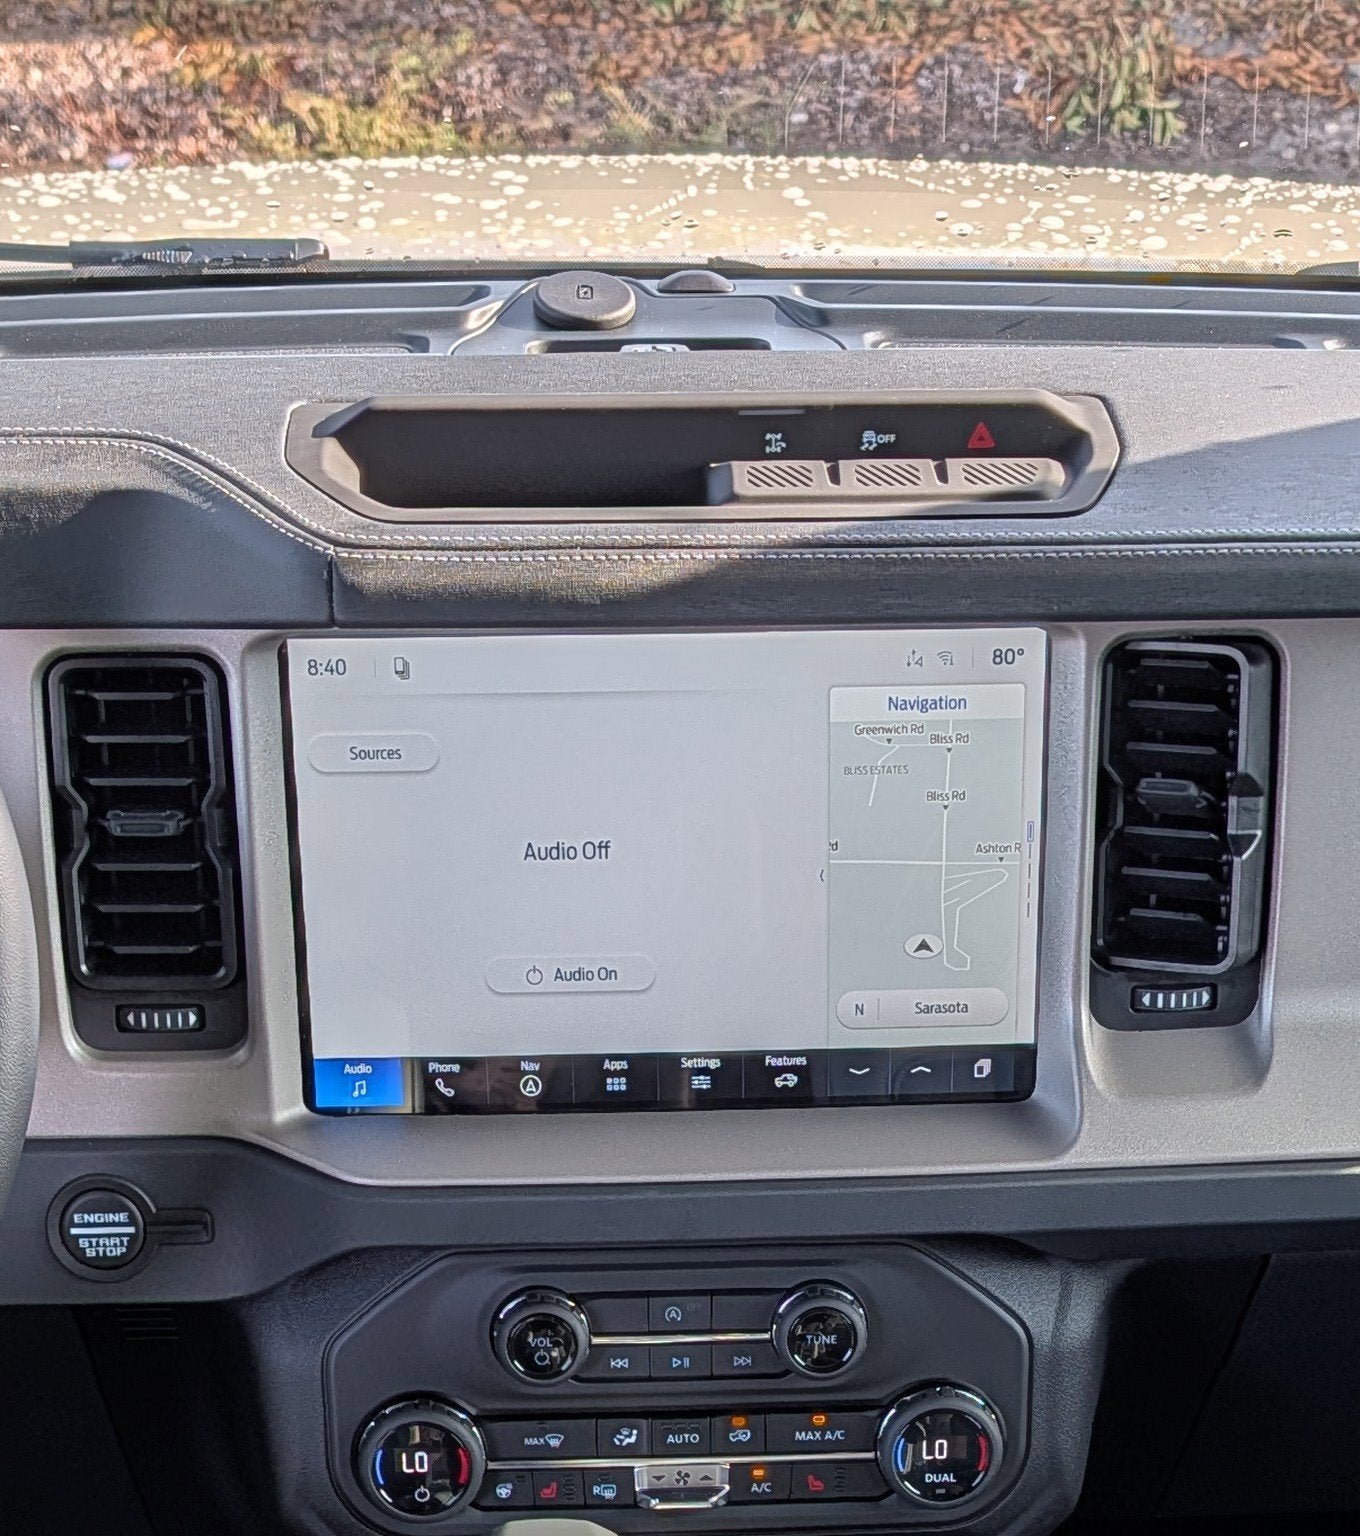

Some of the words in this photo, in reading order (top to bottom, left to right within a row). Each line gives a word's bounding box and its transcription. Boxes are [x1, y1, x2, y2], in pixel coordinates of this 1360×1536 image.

[877, 433, 896, 443] OFF
[307, 658, 347, 676] 8:40
[888, 695, 967, 714] Navigation
[854, 724, 908, 736] Greenwich
[911, 723, 925, 735] Rd
[930, 733, 954, 745] Bliss
[956, 732, 969, 744] Rd
[349, 746, 402, 761] Sources
[844, 765, 868, 776] BLISS
[870, 764, 909, 776] ESTATES
[927, 790, 950, 802] Bliss
[952, 790, 966, 802] Rd
[524, 841, 578, 861] Audio
[582, 840, 611, 860] Off
[975, 842, 1012, 854] Ashton
[554, 967, 594, 982] Audio
[597, 966, 618, 981] On
[855, 1004, 864, 1016] N
[915, 1002, 969, 1015] Sarasota
[521, 1061, 540, 1072] Nav
[603, 1059, 628, 1071] Apps
[681, 1057, 721, 1070] Settings
[765, 1055, 807, 1067] Features
[344, 1063, 372, 1075] Audio
[428, 1062, 460, 1074] Phone
[73, 1212, 130, 1224] ENGINE
[79, 1236, 130, 1248] START
[85, 1247, 127, 1258] STOP
[530, 1336, 552, 1348] VOL
[806, 1335, 837, 1345] TUNE
[524, 1437, 545, 1446] MAX
[666, 1433, 700, 1444] AUTO
[795, 1431, 821, 1441] MAX
[825, 1430, 846, 1441] A/C
[922, 1440, 948, 1459] LO
[402, 1451, 428, 1473] LO
[925, 1473, 957, 1483] DUAL
[751, 1482, 772, 1493] A/C
